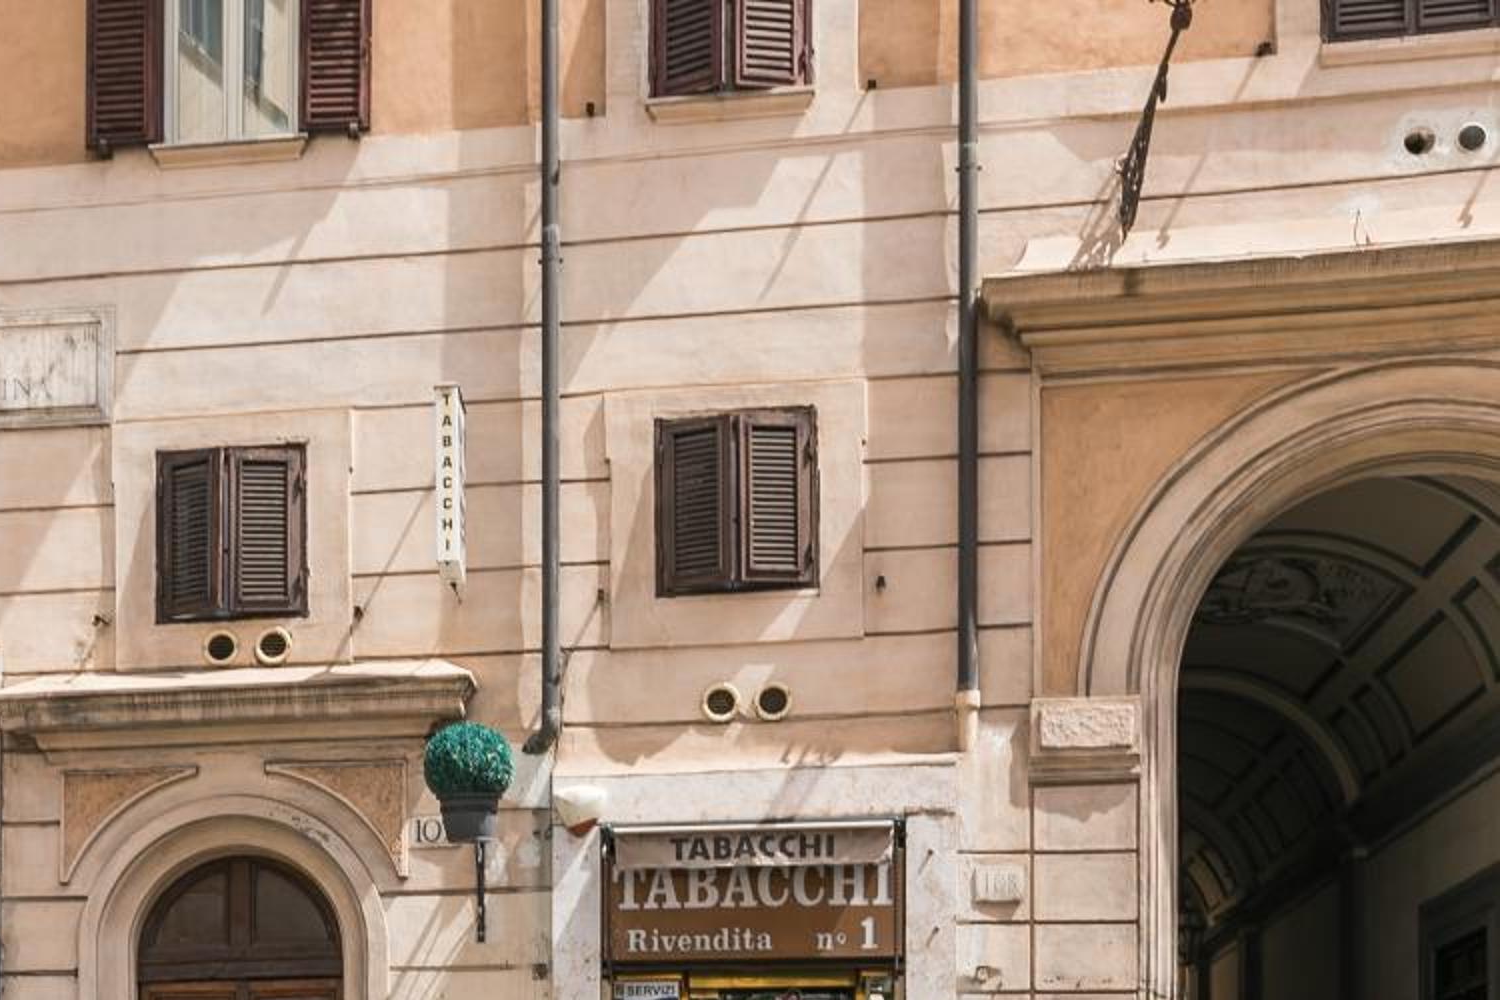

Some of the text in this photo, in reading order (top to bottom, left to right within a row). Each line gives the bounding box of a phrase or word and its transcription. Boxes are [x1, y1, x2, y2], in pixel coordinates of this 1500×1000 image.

[441, 393, 453, 551] TABACCHI
[415, 818, 448, 843] 10
[670, 833, 836, 861] TABACCHI
[612, 860, 894, 911] TABACCHI
[627, 927, 773, 952] Rivendita
[860, 915, 879, 950] 1
[627, 983, 675, 996] SERVIZI
